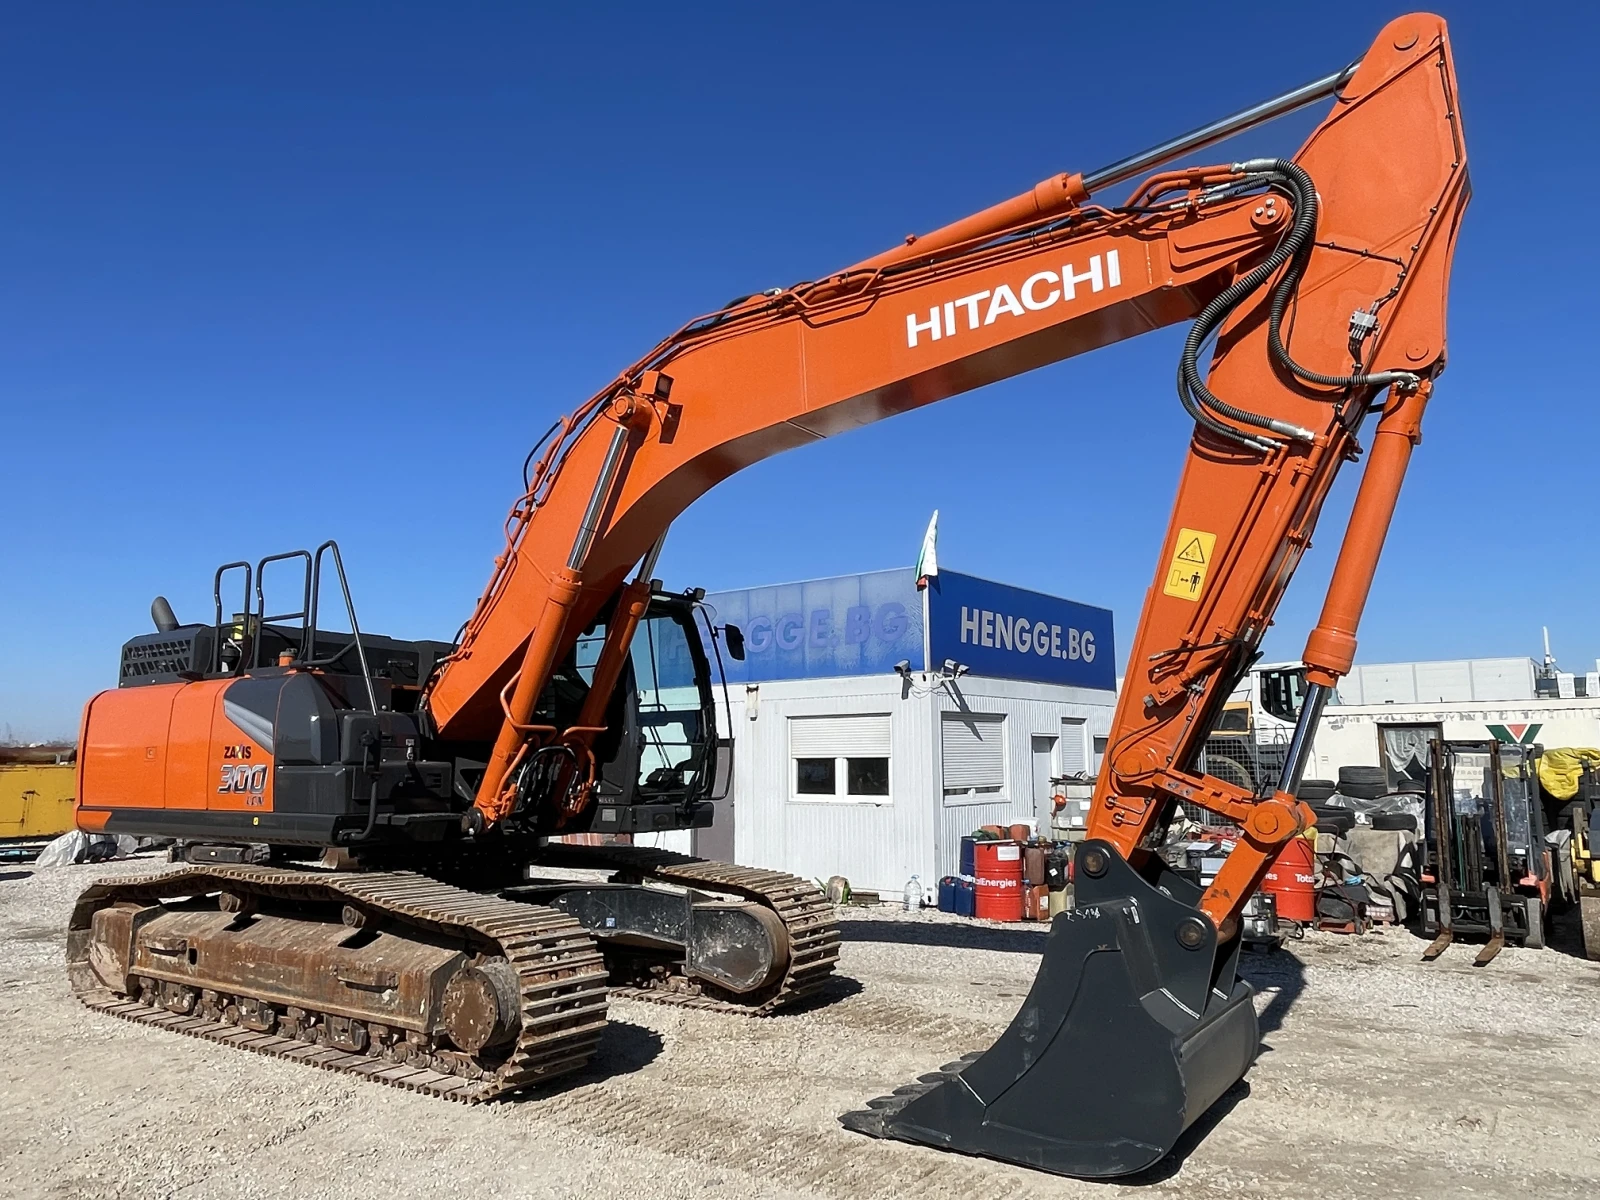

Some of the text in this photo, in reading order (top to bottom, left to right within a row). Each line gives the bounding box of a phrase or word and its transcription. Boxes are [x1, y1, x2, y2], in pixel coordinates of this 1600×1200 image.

[906, 249, 1122, 349] HITACHI
[960, 606, 1096, 663] HENGGE.BG
[217, 764, 269, 795] 300
